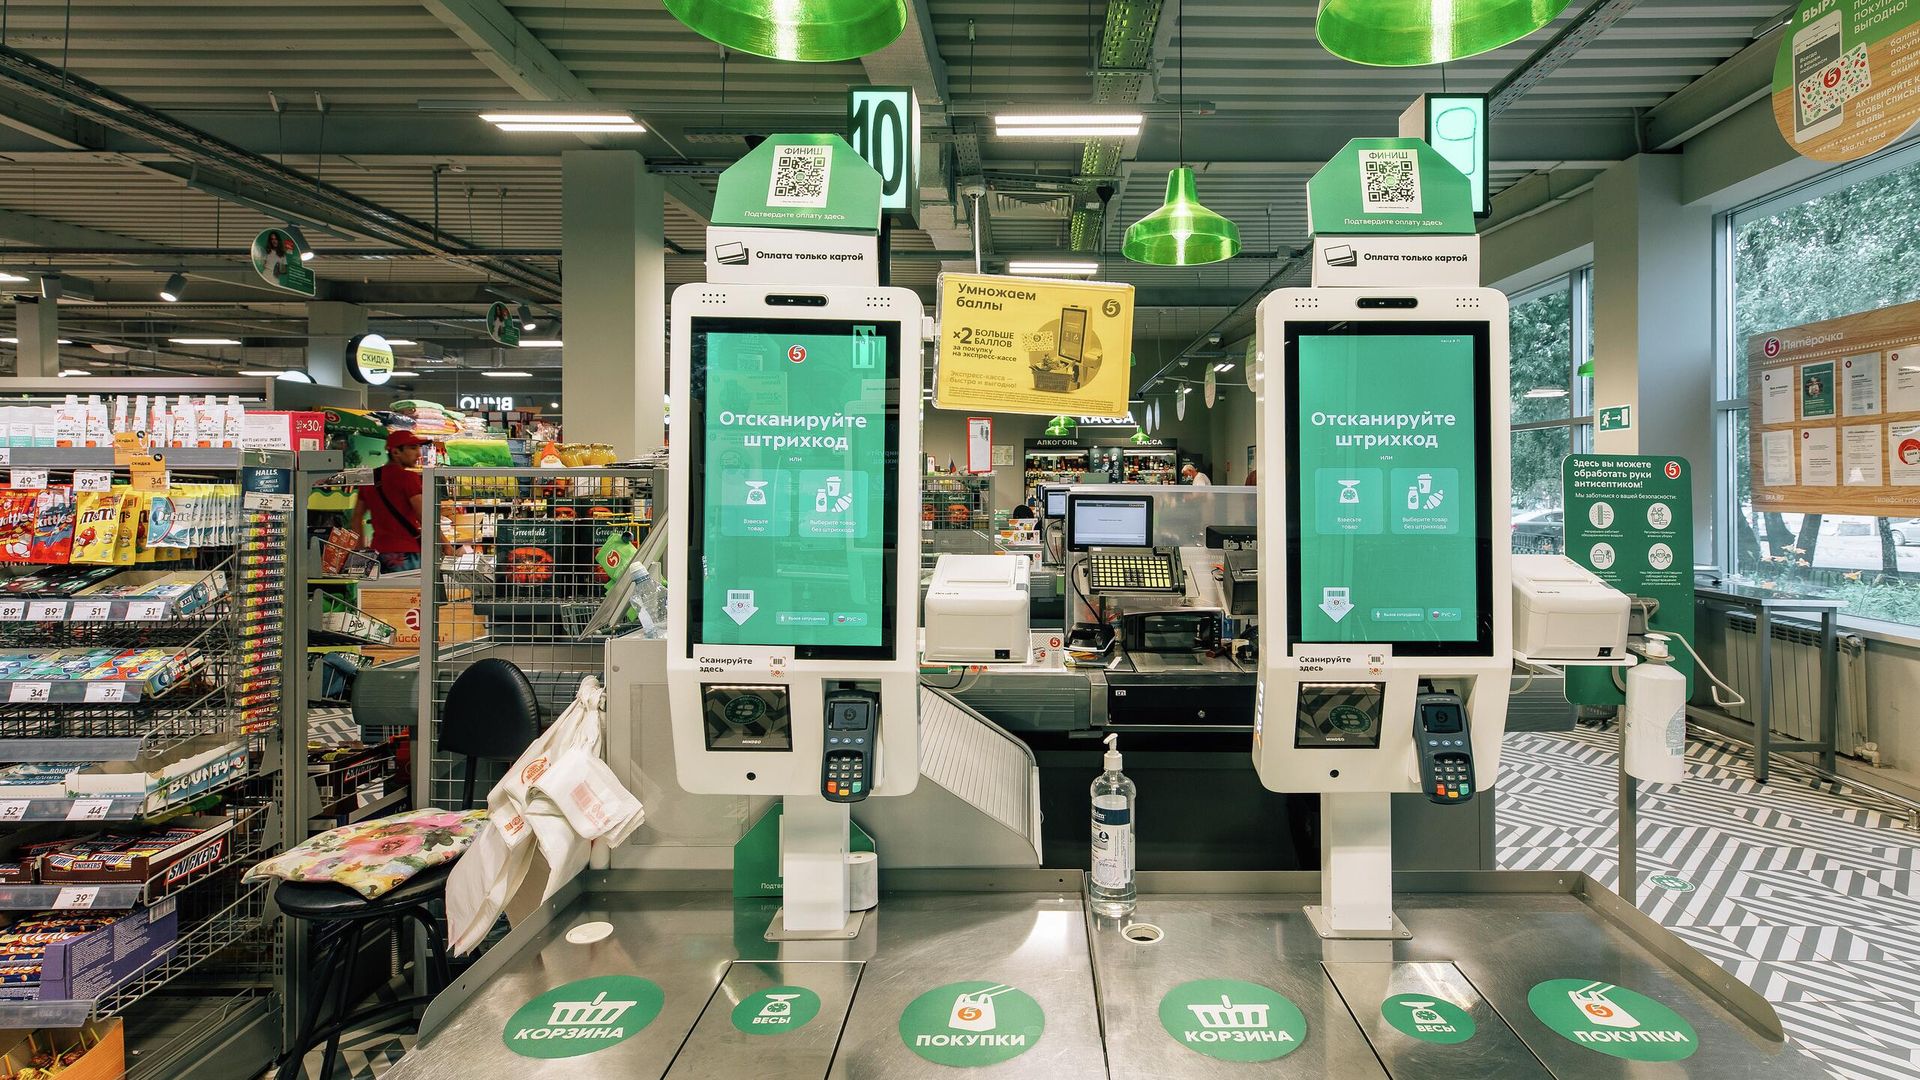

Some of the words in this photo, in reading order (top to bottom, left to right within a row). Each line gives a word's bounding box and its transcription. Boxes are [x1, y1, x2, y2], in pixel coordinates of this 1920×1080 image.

[784, 147, 824, 155] ФИНИШ
[852, 99, 904, 197] 10
[1368, 151, 1408, 159] ФИНИШ
[744, 210, 795, 219] Подтвердите
[796, 211, 822, 220] оплату
[1344, 218, 1394, 226] Подтвердите
[1395, 219, 1421, 227] оплату
[756, 250, 793, 260] Оплата
[830, 251, 864, 262] картой
[1363, 253, 1399, 261] Оплата
[1401, 254, 1433, 262] только
[1435, 253, 1468, 263] картой
[958, 283, 1037, 301] Умножаем
[956, 296, 1003, 311] баллы
[975, 328, 1015, 339] БОЛЬШЕ
[974, 337, 1013, 348] БАЛЛОВ
[1783, 331, 1844, 350] Пятёрочка
[962, 345, 993, 354] покупку
[361, 353, 390, 365] СКИДКА
[963, 352, 1017, 362] экспресс-кассе
[719, 410, 868, 431] Отсканируйте
[1311, 410, 1456, 429] Отсканируйте
[743, 432, 849, 451] штрихкод
[1335, 433, 1439, 450] штрихкод
[1573, 459, 1600, 468] Здесь
[1616, 461, 1652, 469] можете
[255, 469, 278, 477] HALLS
[1573, 469, 1628, 479] обработать
[1629, 471, 1652, 480] руки
[1574, 480, 1643, 489] антисептиком!
[699, 656, 753, 666] Сканируйте
[1299, 655, 1352, 664] Сканируйте
[699, 665, 724, 673] здесь
[1299, 664, 1324, 672] здесь
[169, 756, 230, 796] BOUNTY
[74, 862, 102, 870] SNICKERS
[169, 843, 220, 880] SNICKERS
[752, 1015, 791, 1025] ВЕСЫ
[513, 1025, 625, 1041] КОРЗИНА
[1415, 1022, 1456, 1034] ВЕСЫ
[915, 1032, 1026, 1047] ПОКУПКИ
[1184, 1029, 1295, 1044] КОРЗИНА
[1573, 1029, 1690, 1044] ПОКУПКИ
